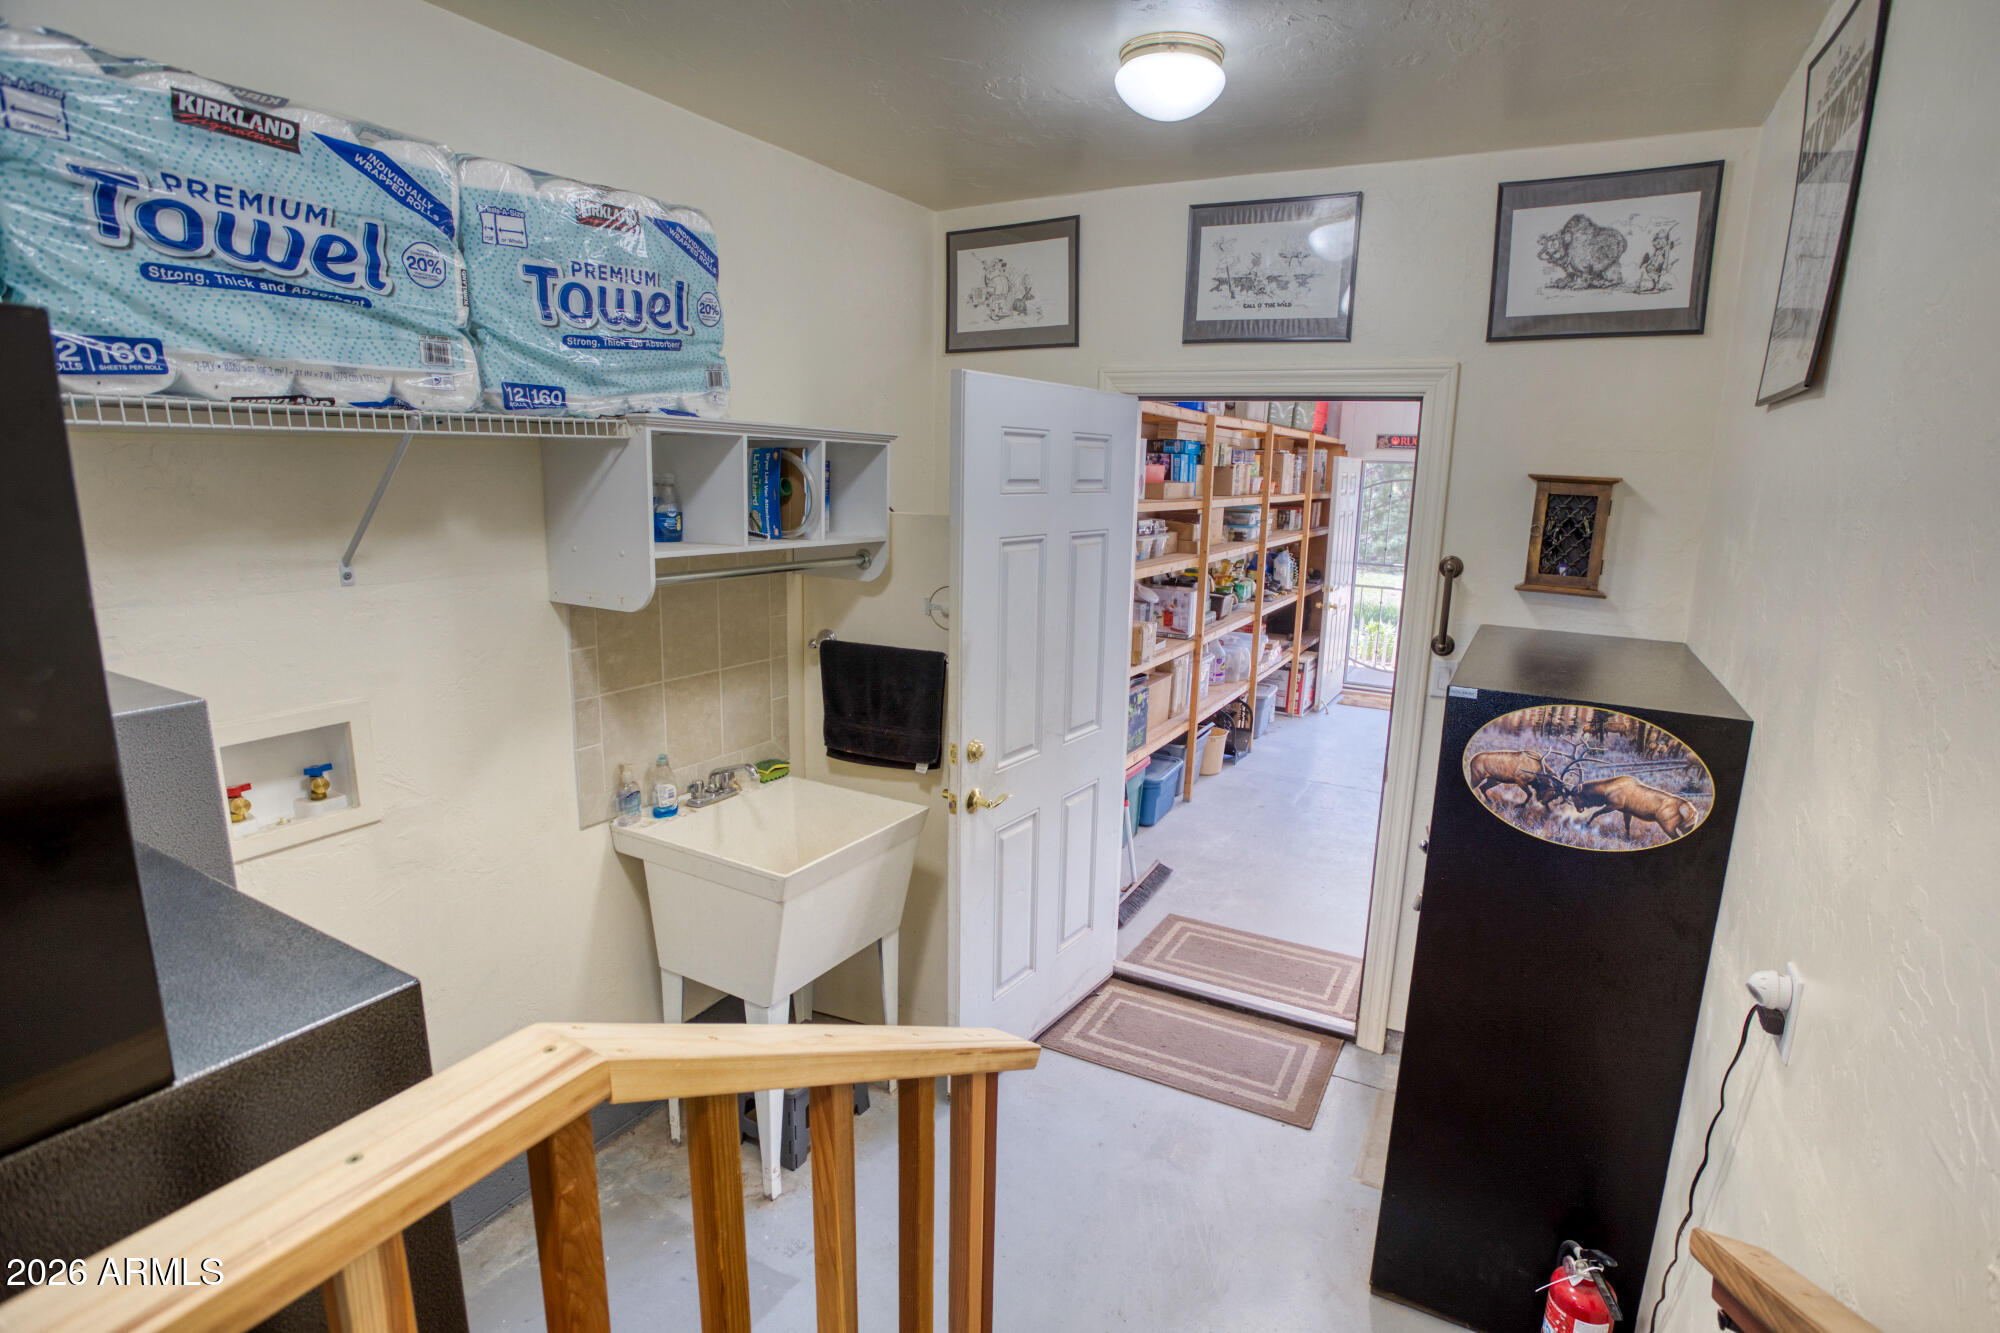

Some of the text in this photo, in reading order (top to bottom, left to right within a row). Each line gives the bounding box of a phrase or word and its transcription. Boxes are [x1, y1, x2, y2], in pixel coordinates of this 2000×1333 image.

[177, 93, 296, 140] KIRKLAND
[160, 172, 330, 227] PREMIUM
[354, 153, 440, 221] WRAPPED ROLLS
[367, 152, 434, 210] INDIVIDUALLY
[64, 161, 387, 291] Towel
[675, 225, 715, 263] INDIVIDUALLY
[406, 255, 442, 275] 20%
[668, 227, 717, 274] WRAPPED ROLLS
[148, 266, 365, 307] Strong, Thick and Absorbent
[571, 260, 656, 287] PREMIUM
[522, 263, 689, 331] Towel
[699, 302, 719, 316] 20%
[56, 340, 158, 364] 2 160
[567, 337, 600, 348] Strong,
[604, 338, 625, 347] Thick
[56, 361, 83, 371] OLLS
[506, 386, 562, 406] 12 160
[752, 474, 760, 506] Lizard
